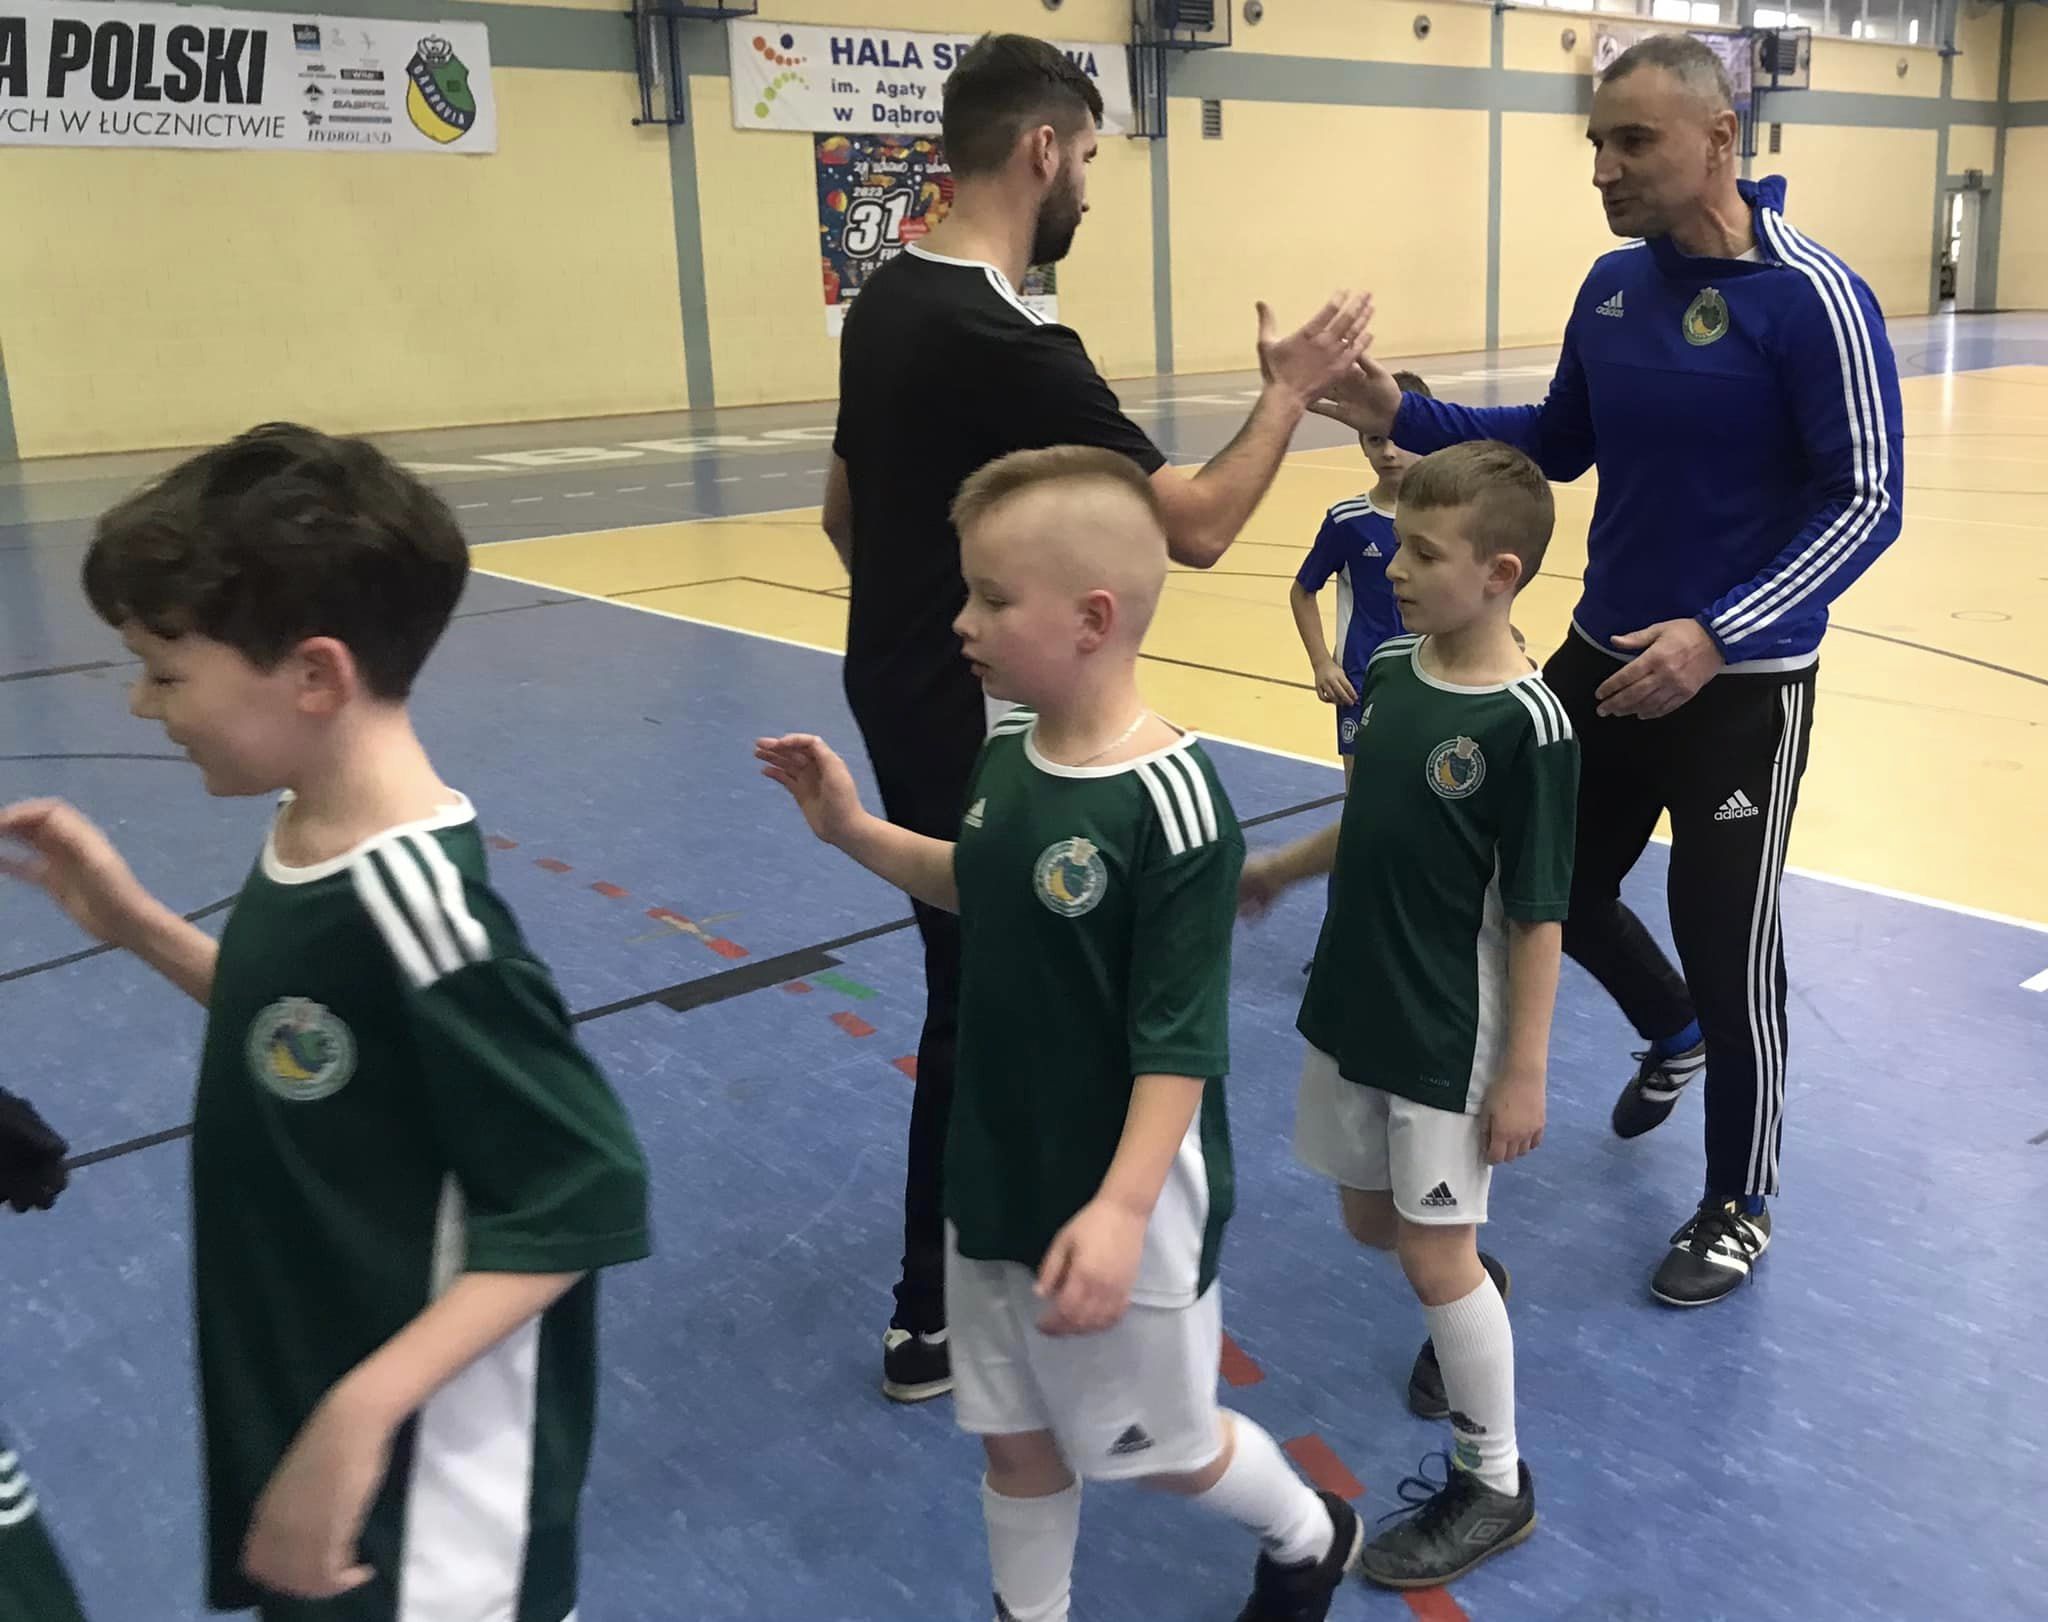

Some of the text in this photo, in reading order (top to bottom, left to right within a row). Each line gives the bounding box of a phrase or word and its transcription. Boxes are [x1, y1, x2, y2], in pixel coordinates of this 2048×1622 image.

[46, 18, 268, 105] POLSKI
[830, 37, 924, 69] HALA
[831, 79, 927, 99] im. Agaty
[0, 108, 286, 138] CH W ŁUCZNICTWIE
[833, 107, 854, 122] w
[308, 129, 392, 144] HYDROLAND
[846, 191, 911, 255] 31
[1714, 806, 1759, 821] adidas
